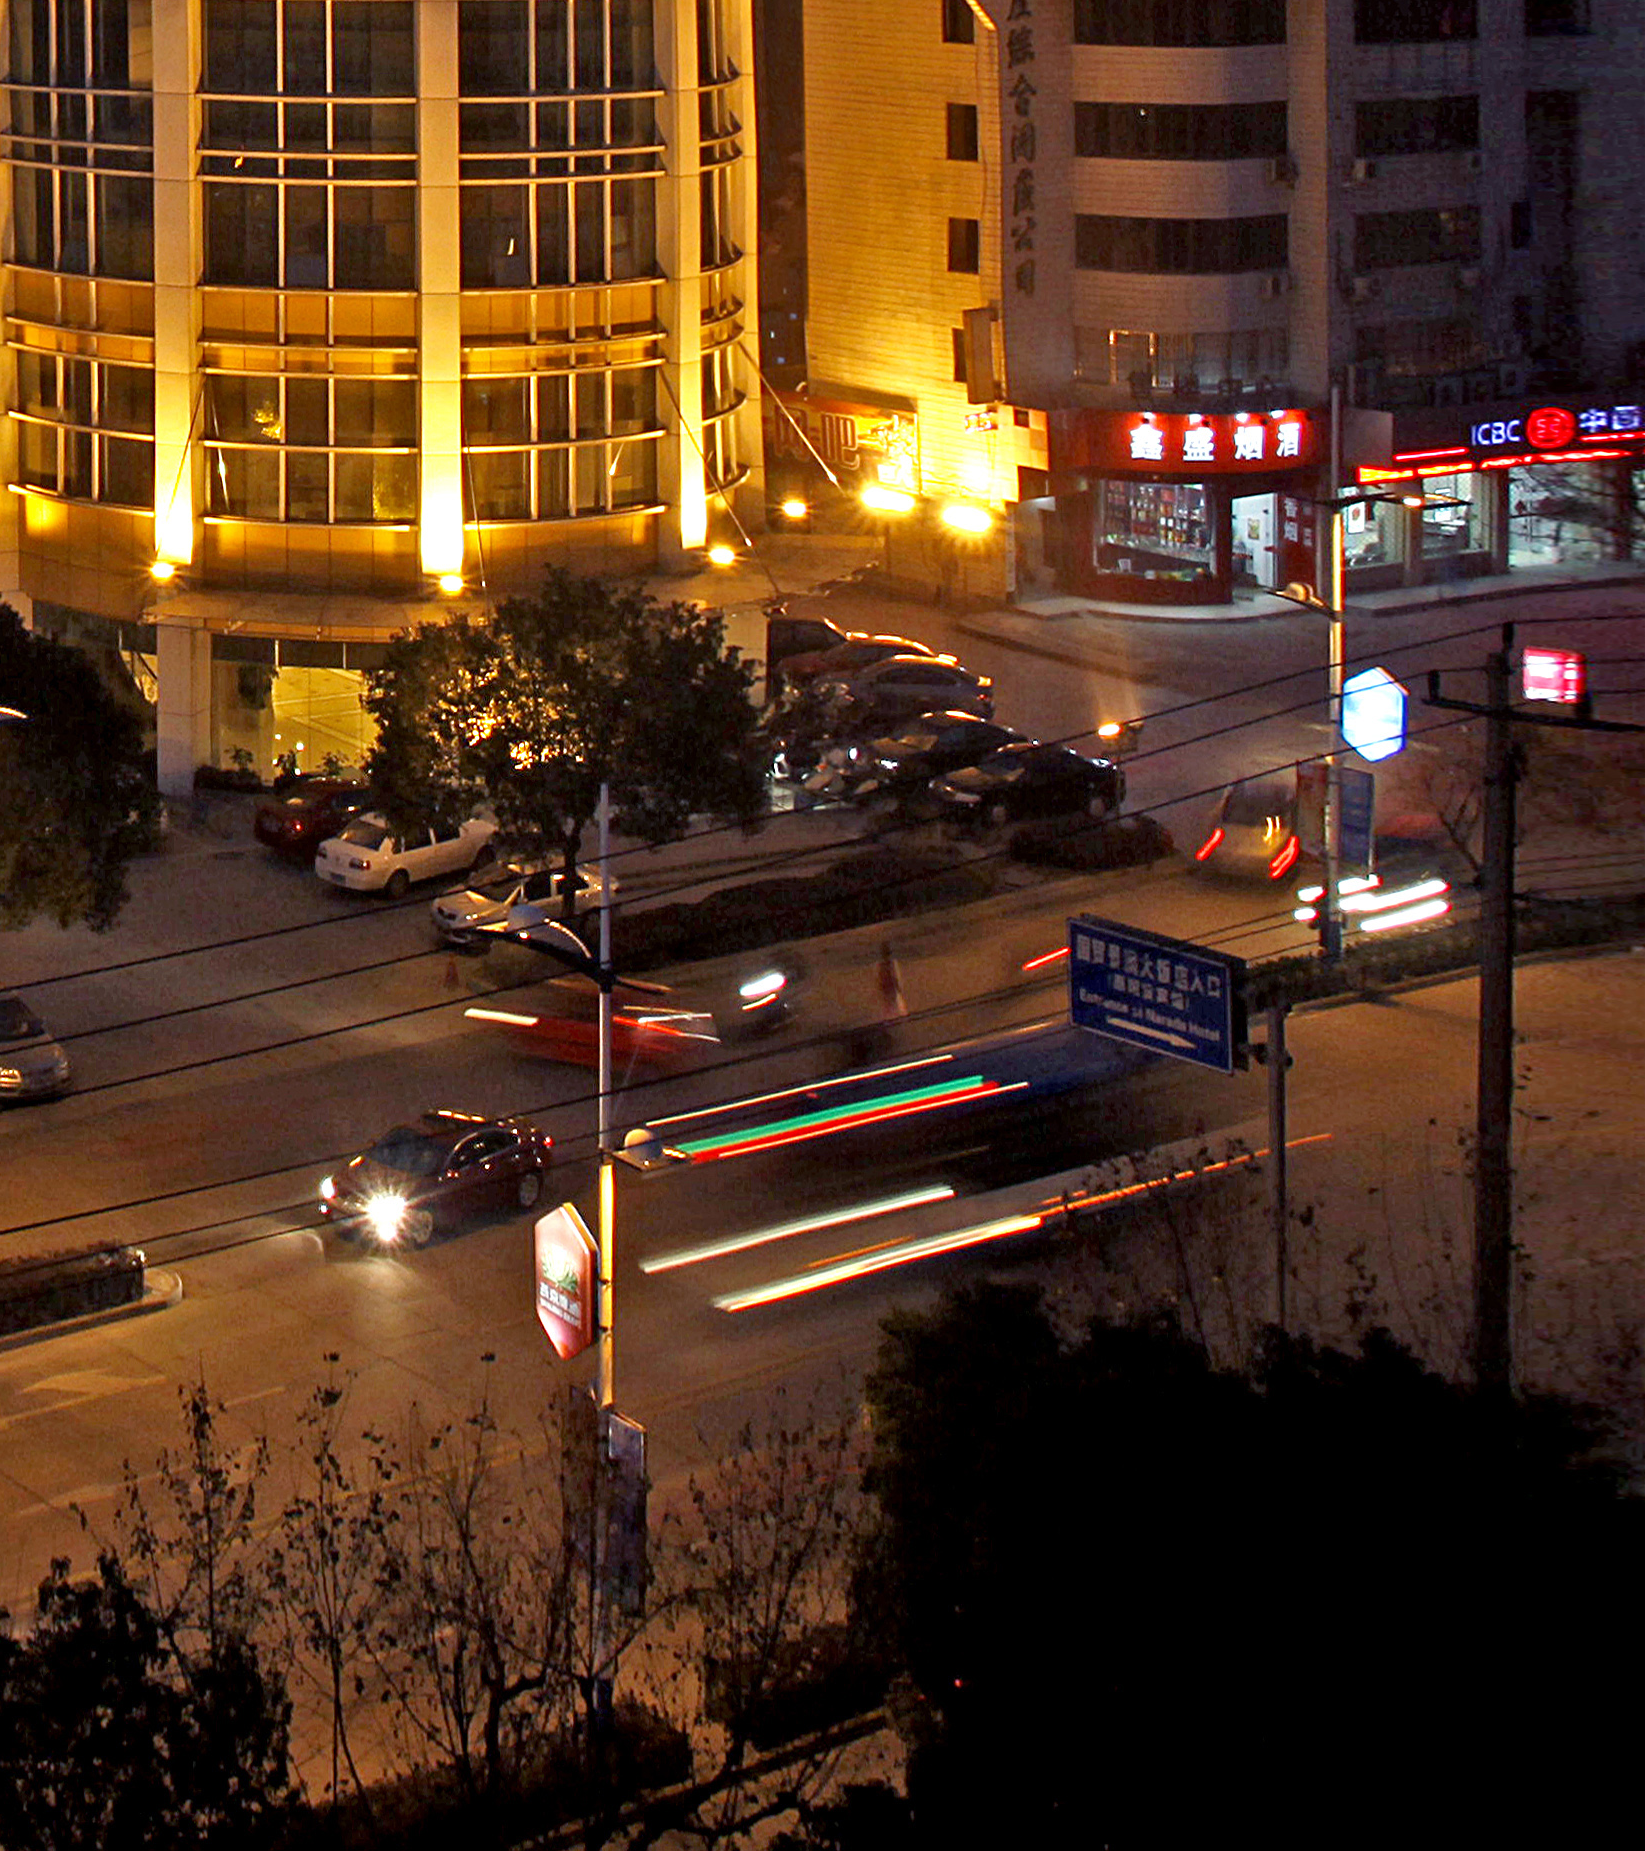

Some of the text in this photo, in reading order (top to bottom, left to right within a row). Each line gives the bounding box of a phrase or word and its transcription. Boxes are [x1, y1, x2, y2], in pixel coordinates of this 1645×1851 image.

[1129, 423, 1301, 462] 鑫盛烟酒
[1471, 419, 1521, 446] ICBC
